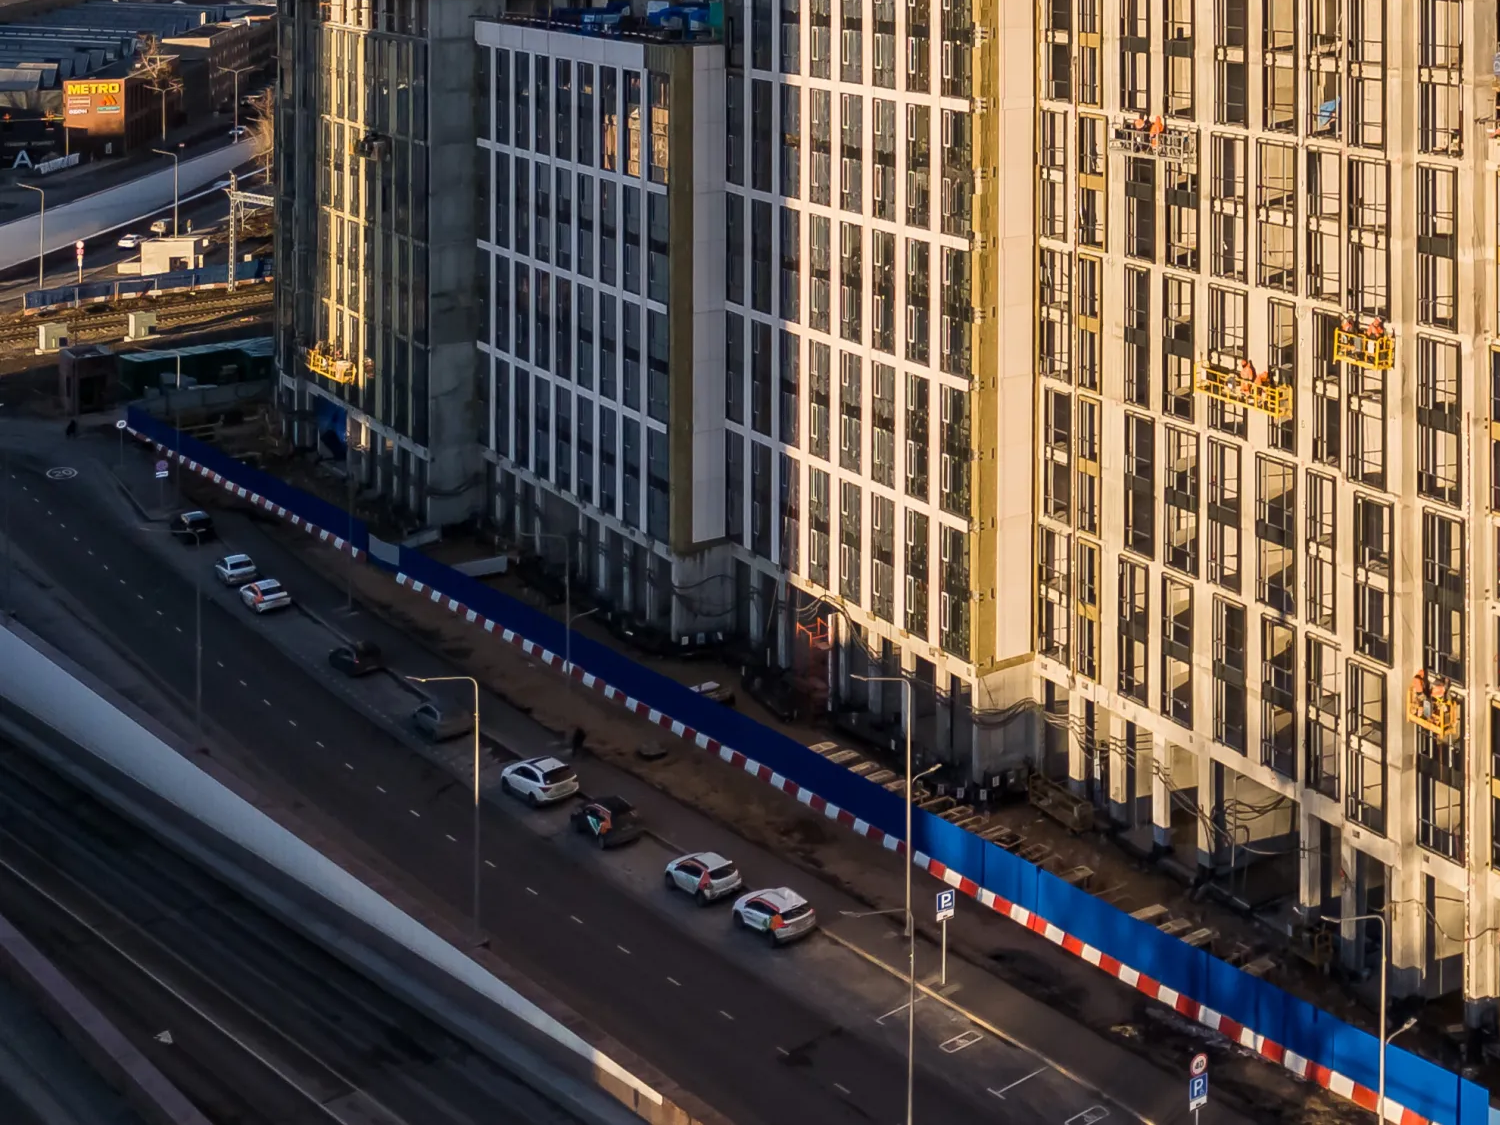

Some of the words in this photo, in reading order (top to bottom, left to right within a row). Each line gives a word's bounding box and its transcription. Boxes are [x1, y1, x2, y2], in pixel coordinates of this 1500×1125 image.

[67, 83, 120, 94] METRO
[941, 893, 951, 909] P
[1194, 1078, 1204, 1096] P
